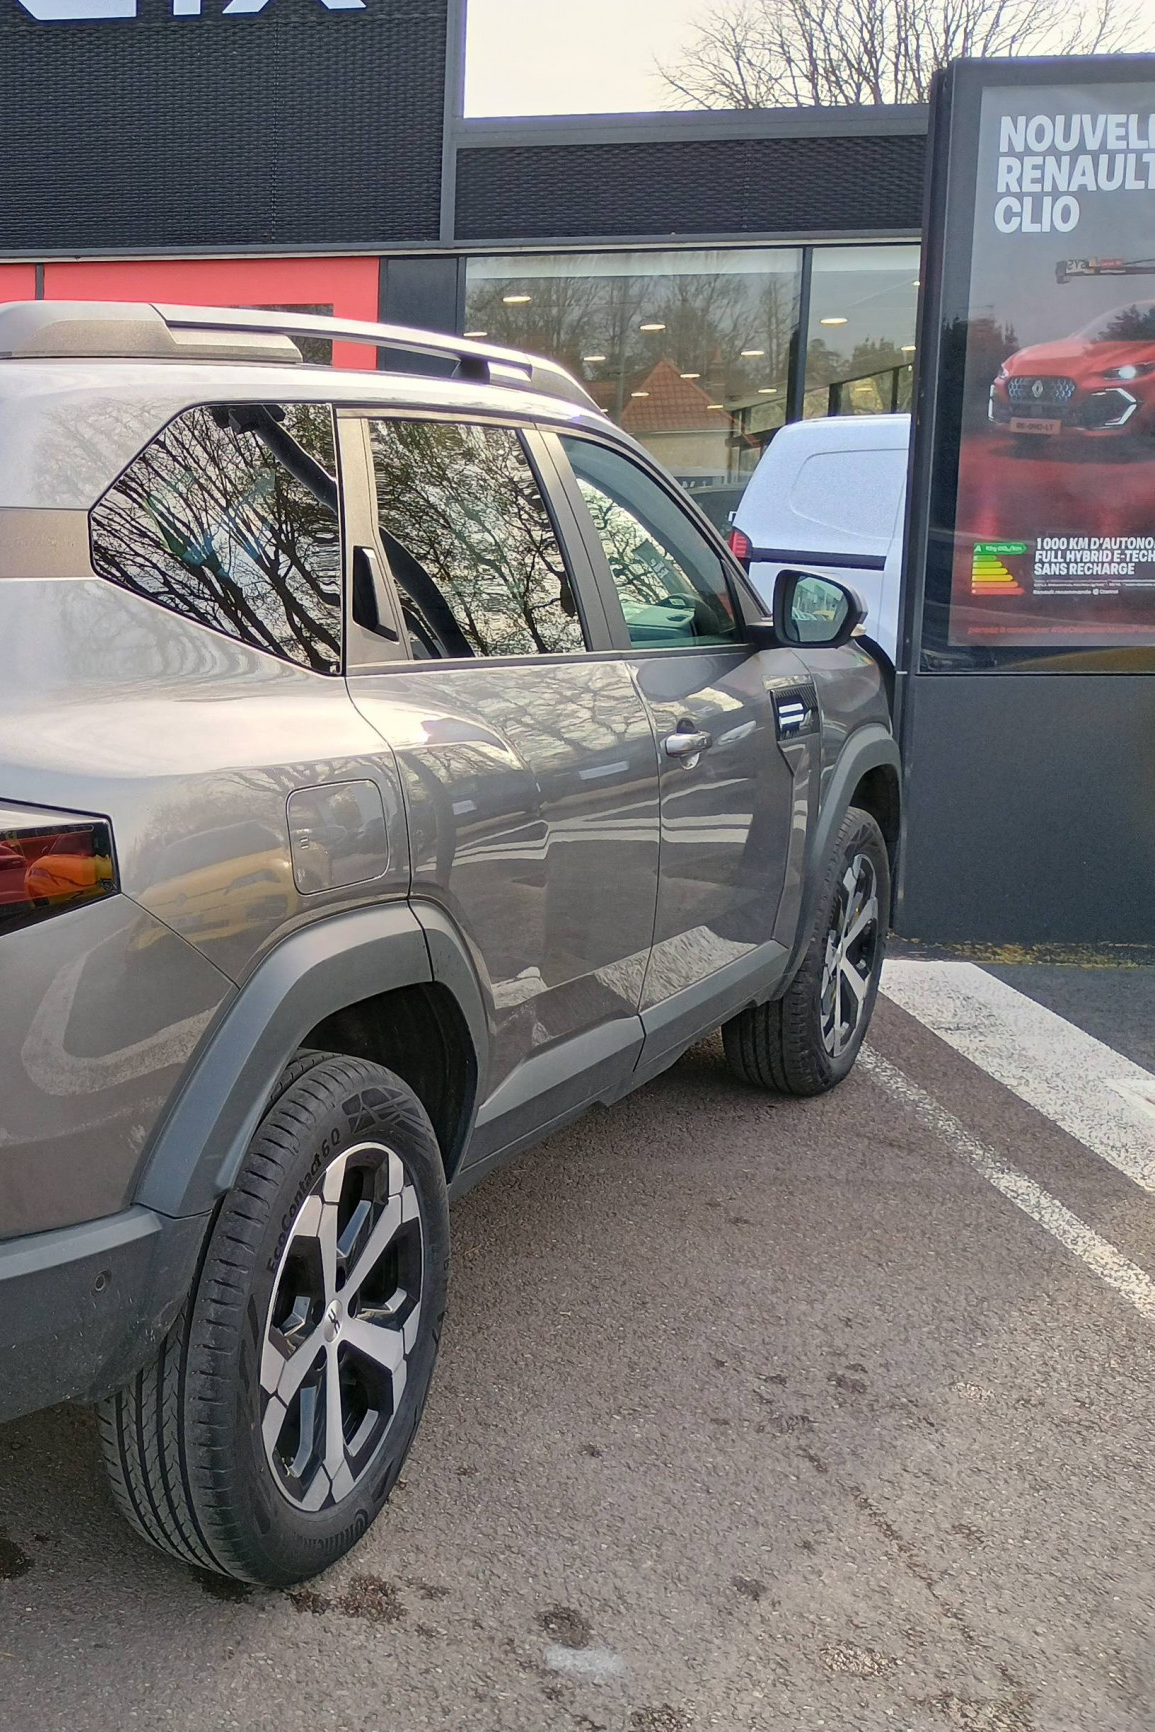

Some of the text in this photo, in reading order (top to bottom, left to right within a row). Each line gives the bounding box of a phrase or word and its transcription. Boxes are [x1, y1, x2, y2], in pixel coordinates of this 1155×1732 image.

[996, 153, 1155, 192] RENAULT
[994, 195, 1080, 233] CLIO
[1069, 537, 1089, 549] KM
[1090, 537, 1155, 549] D'AUTONO
[1035, 550, 1155, 563] FULL HYBRID E-TECH
[1034, 562, 1135, 575] SANS RECHARGE
